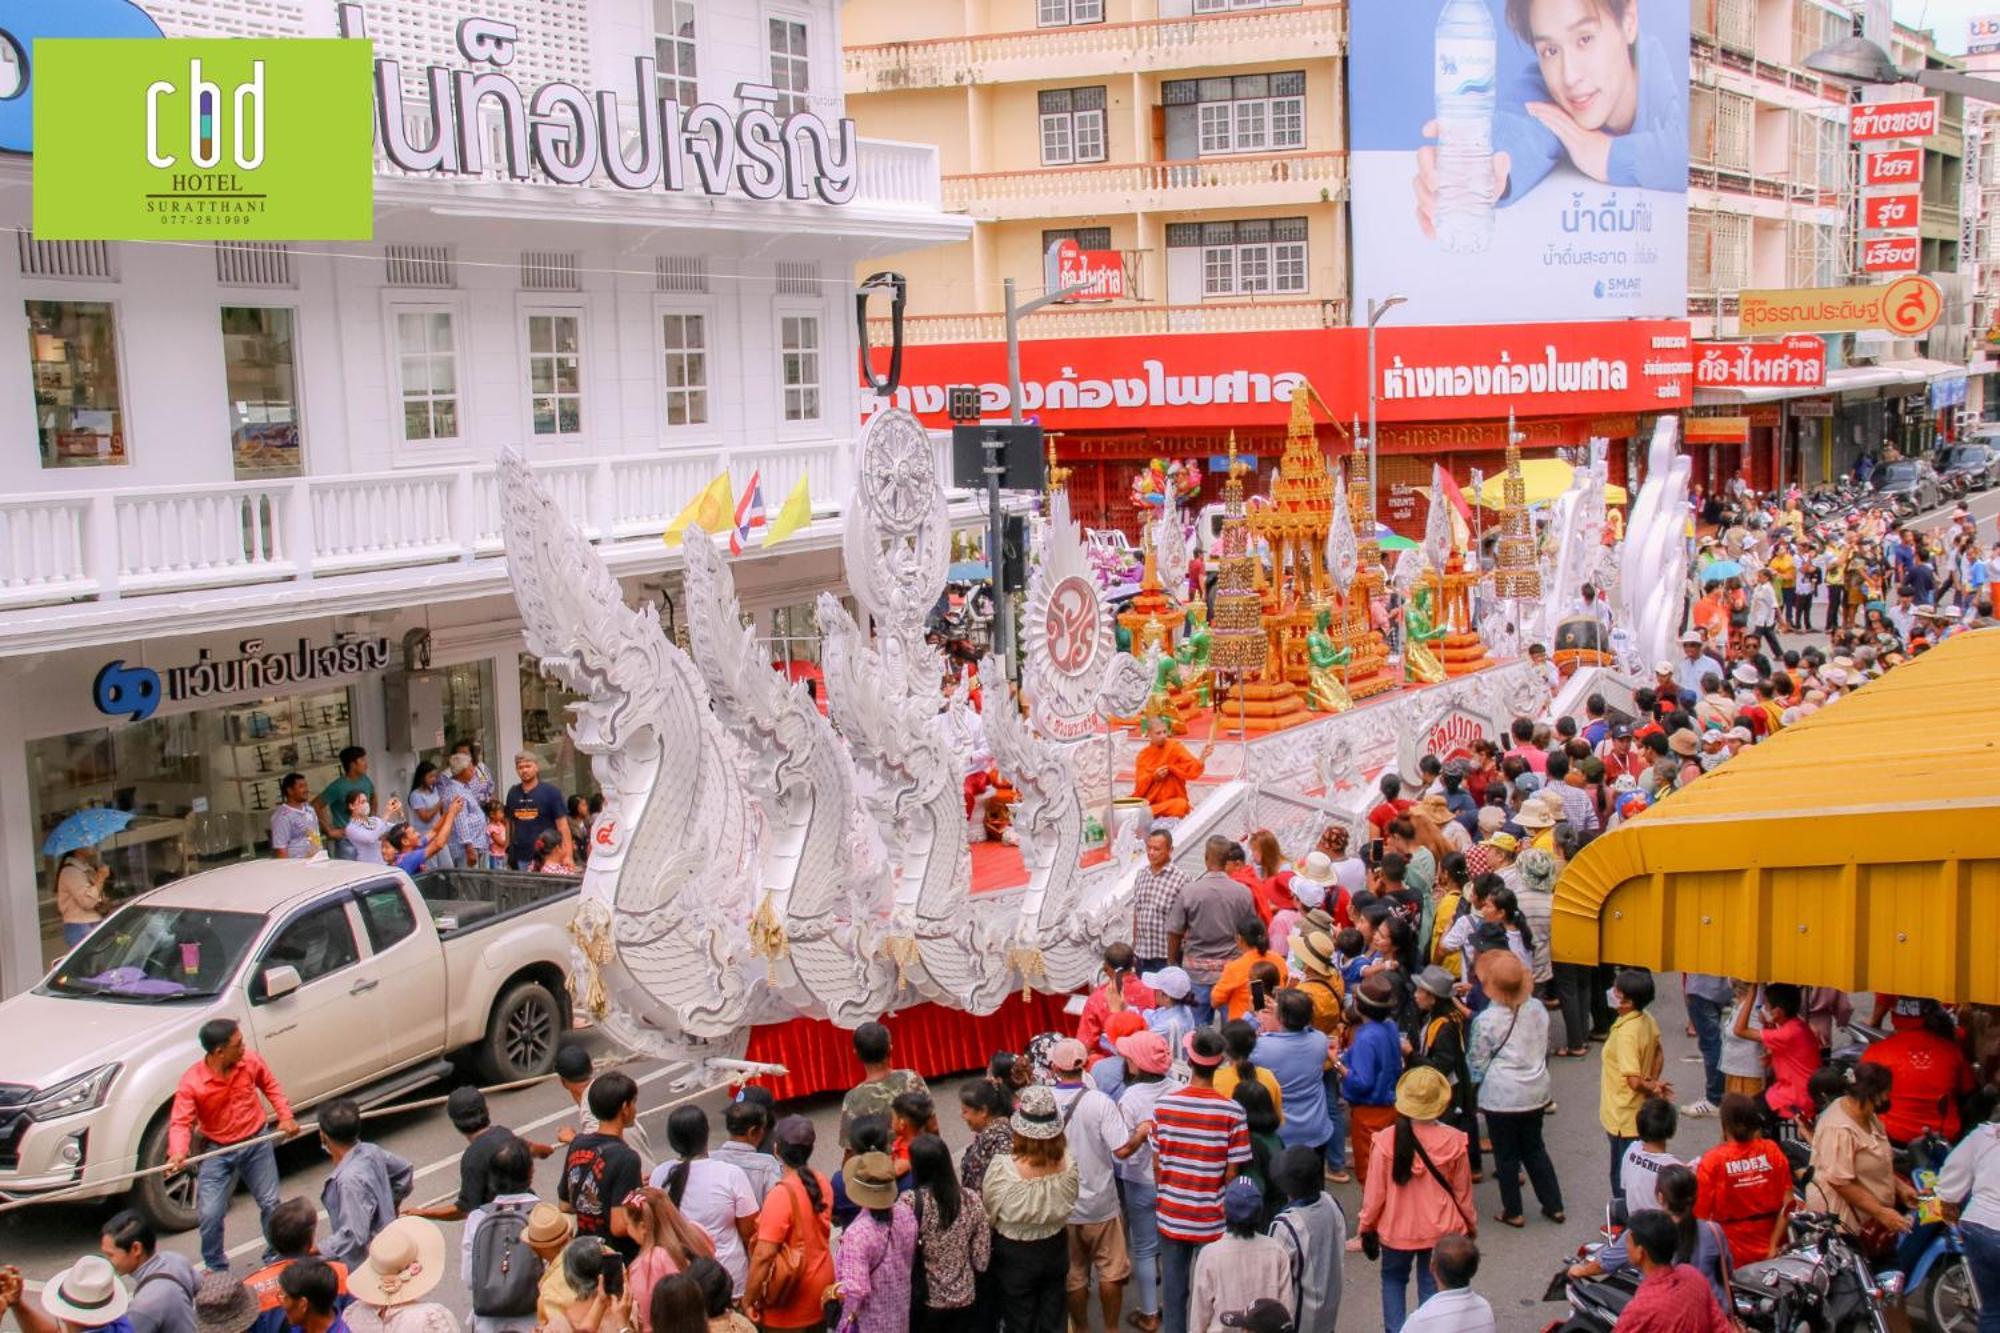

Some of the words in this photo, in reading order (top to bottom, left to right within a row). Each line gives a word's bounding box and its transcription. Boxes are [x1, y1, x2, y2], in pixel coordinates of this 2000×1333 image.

[340, 3, 857, 205] ่นท็อปเจริญ
[1853, 107, 1933, 135] ห้างทอง
[1873, 154, 1914, 178] โชค
[1877, 198, 1906, 227] รุ่ง
[1866, 242, 1915, 265] เรือง
[1384, 345, 1628, 399] ห้างทองก้องไพศาล
[1698, 346, 1820, 382] ก้องไพศาล
[170, 638, 391, 700] แว่นท็อปเจริญ
[1725, 1154, 1772, 1174] INDEX
